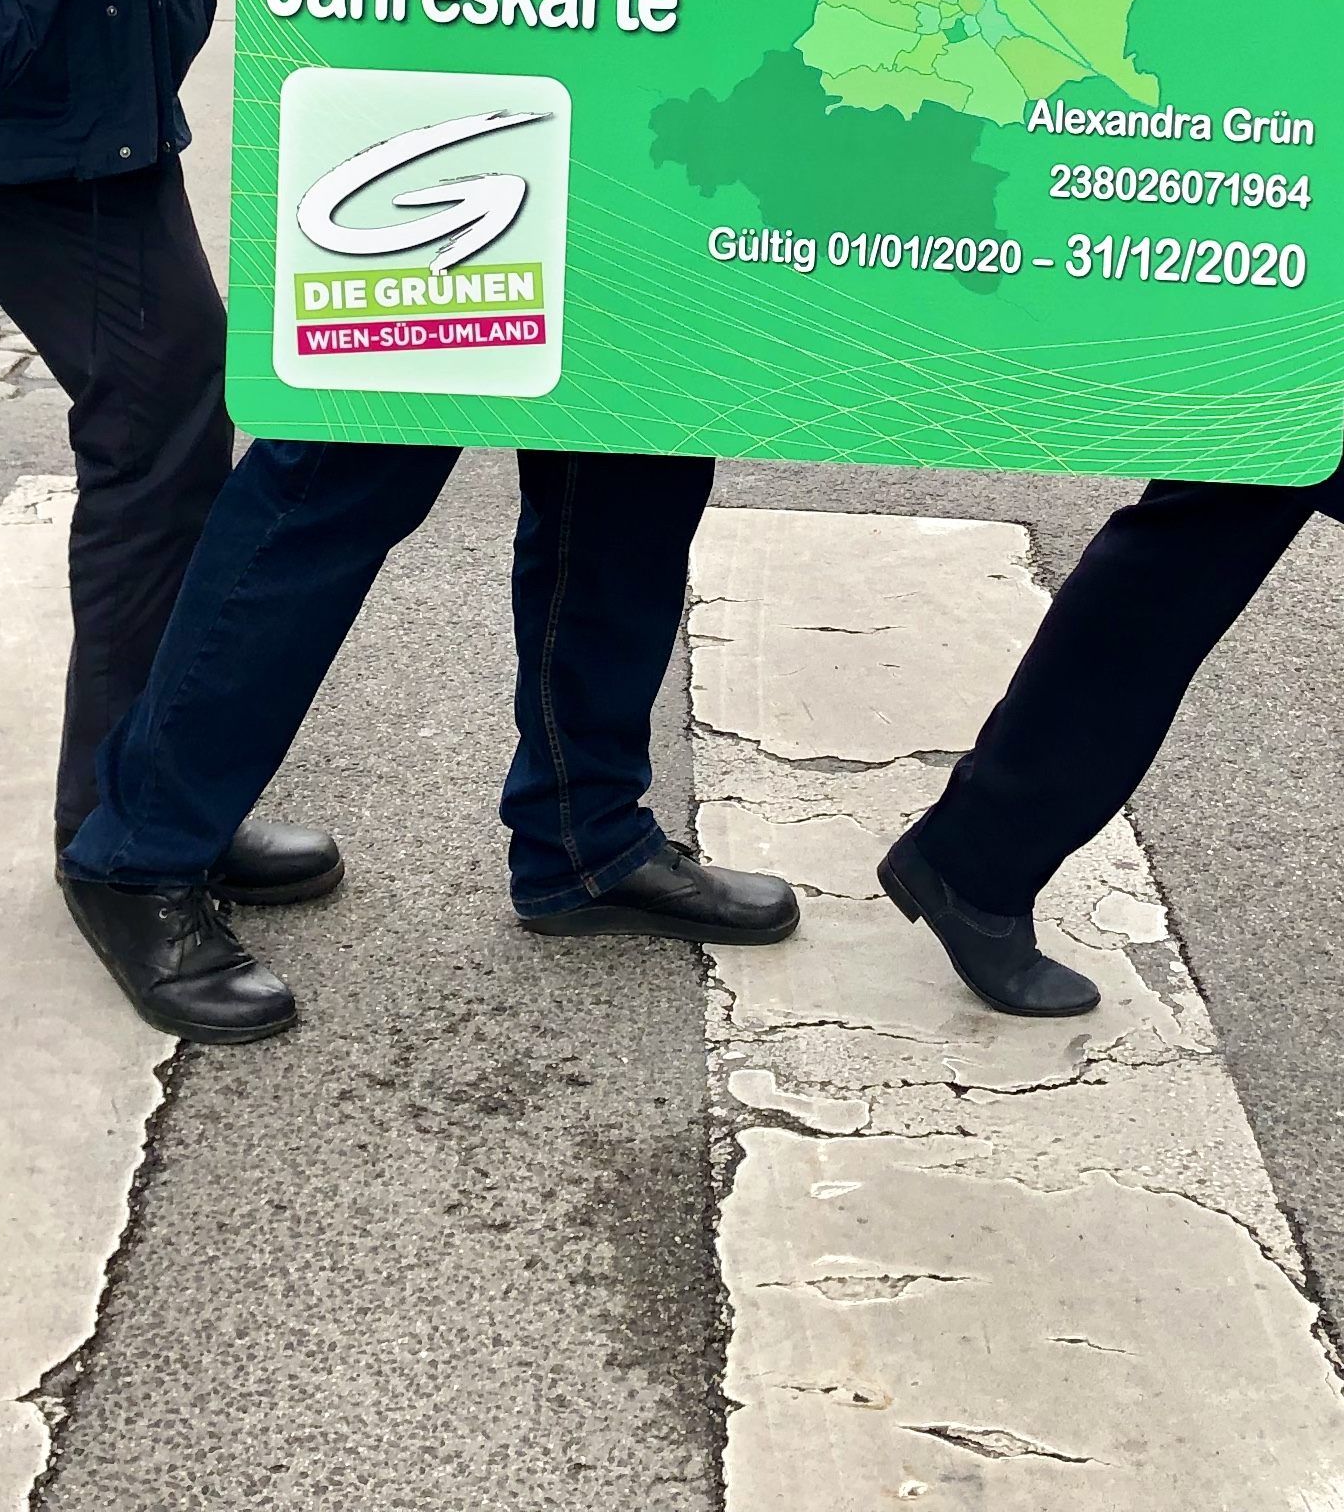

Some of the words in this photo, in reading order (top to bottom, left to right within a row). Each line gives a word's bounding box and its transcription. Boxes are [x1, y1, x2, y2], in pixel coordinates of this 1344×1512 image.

[1027, 98, 1211, 141] Alexandra
[1222, 107, 1315, 145] Grün
[1049, 164, 1311, 209] 238026071964
[707, 226, 817, 273] Gültig
[827, 231, 1022, 275] 01/01/2020
[1064, 233, 1307, 289] 31/12/2020
[303, 279, 368, 311] DIE
[374, 270, 535, 308] GRÜNEN
[306, 320, 539, 351] WIEN-SÜD-UMLAND
